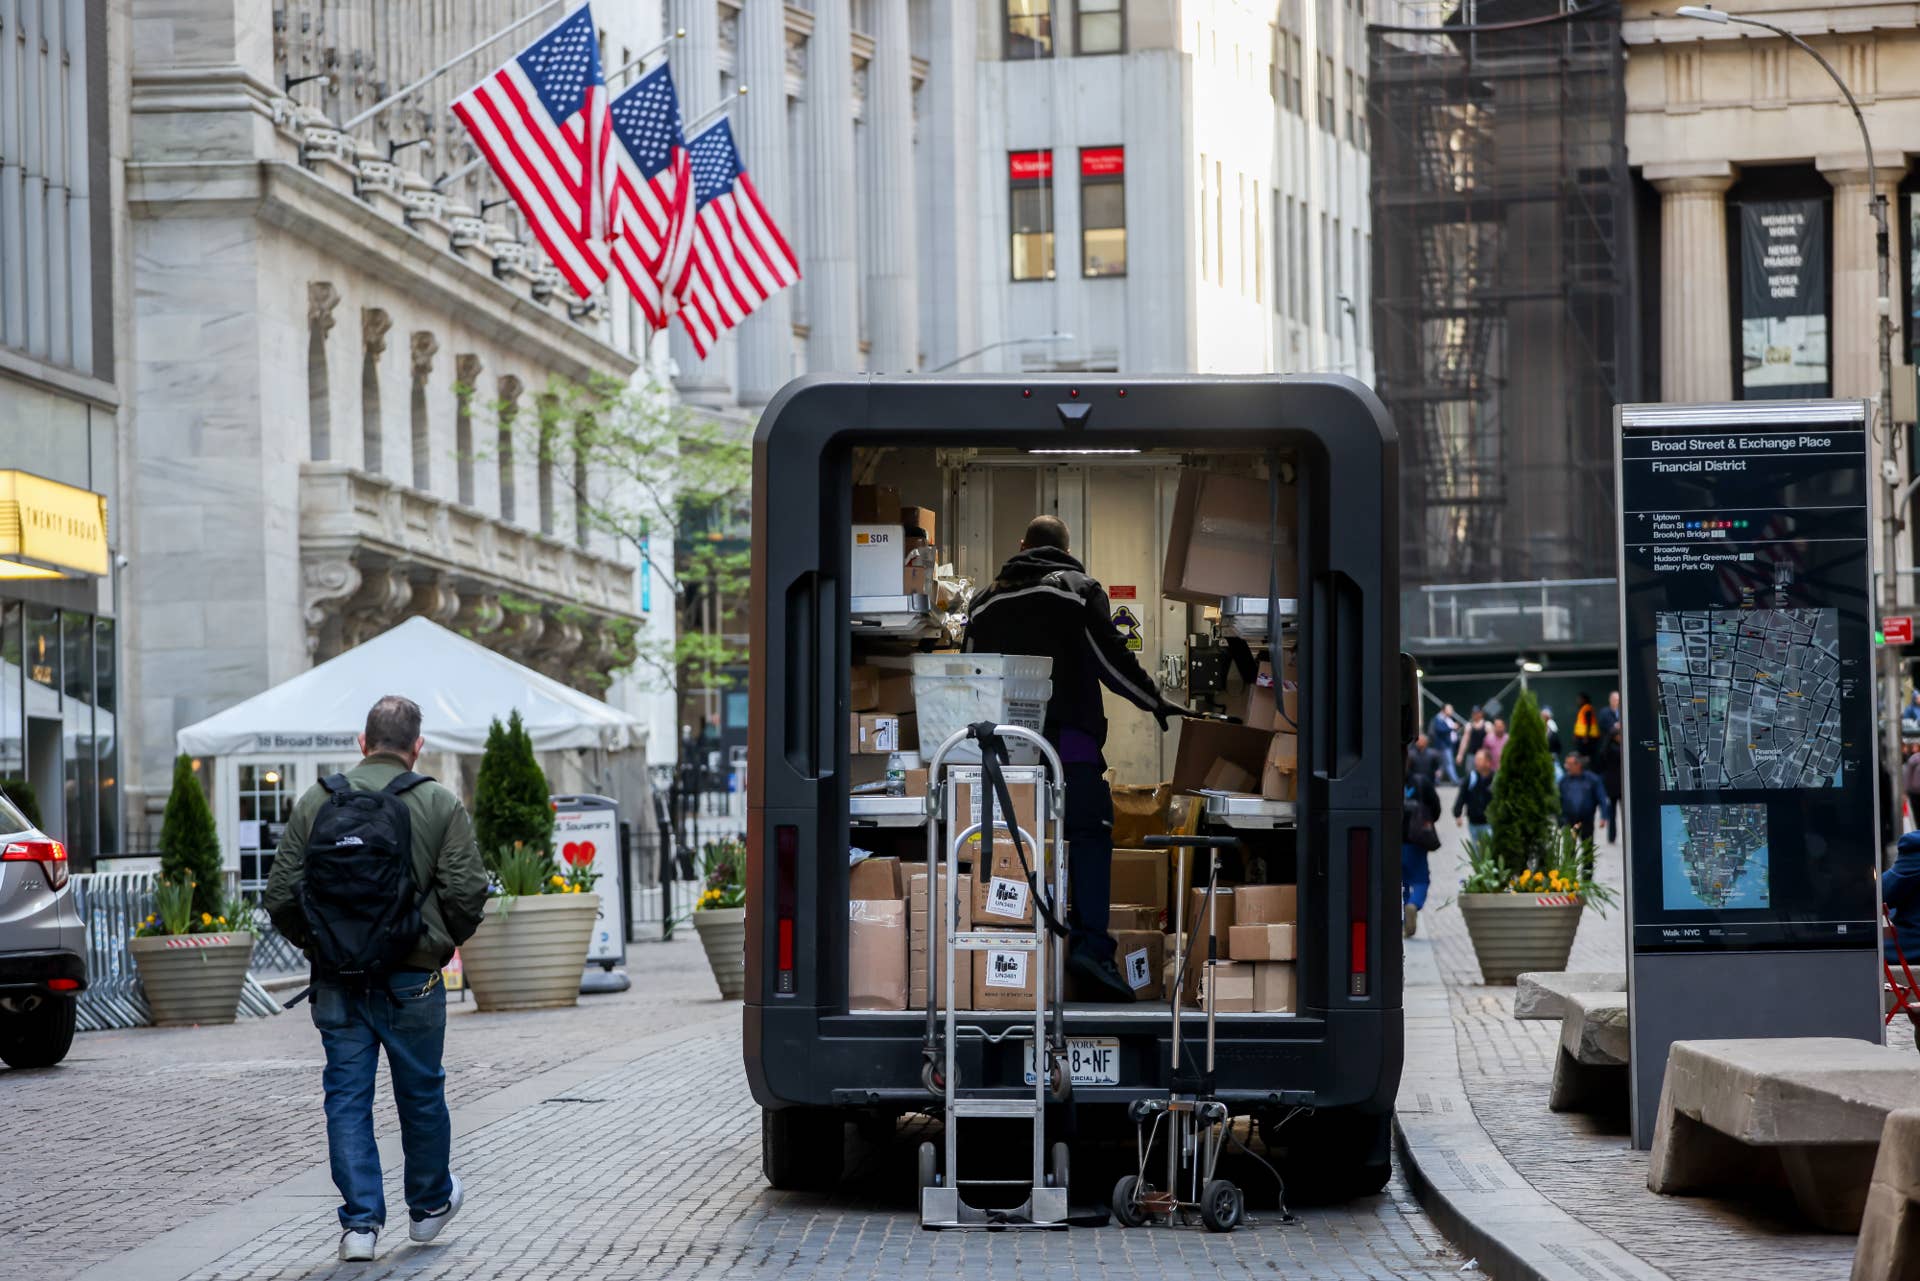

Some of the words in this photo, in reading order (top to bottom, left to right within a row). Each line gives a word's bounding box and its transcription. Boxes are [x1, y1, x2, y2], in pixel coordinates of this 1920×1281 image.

[1761, 214, 1804, 226] WOMEN'S
[1769, 226, 1797, 237] WORK
[1768, 244, 1797, 255] NEVER
[1763, 256, 1802, 267] PRAISED
[1768, 275, 1799, 286] NEVER
[1771, 287, 1796, 298] DONE
[1651, 440, 1686, 451] Broad
[1689, 438, 1724, 450] Street
[1727, 438, 1736, 449] &
[1739, 437, 1796, 450] Exchange
[1799, 436, 1831, 447] Place
[1652, 461, 1701, 472] Financial
[1704, 460, 1746, 471] District
[26, 506, 62, 533] TWENTY
[1652, 513, 1680, 521] Uptown
[1676, 521, 1684, 529] St
[870, 534, 889, 543] SDR
[1653, 531, 1685, 539] Brooklyn
[1686, 531, 1710, 539] Bridge
[1703, 553, 1739, 561] Greenway
[1654, 564, 1680, 572] Battery
[1699, 562, 1715, 570] City
[274, 735, 313, 746] Broad
[316, 735, 354, 746] Street
[566, 822, 610, 832] Souvenirs
[1662, 929, 1680, 937] Walk
[1071, 1040, 1095, 1049] YORK
